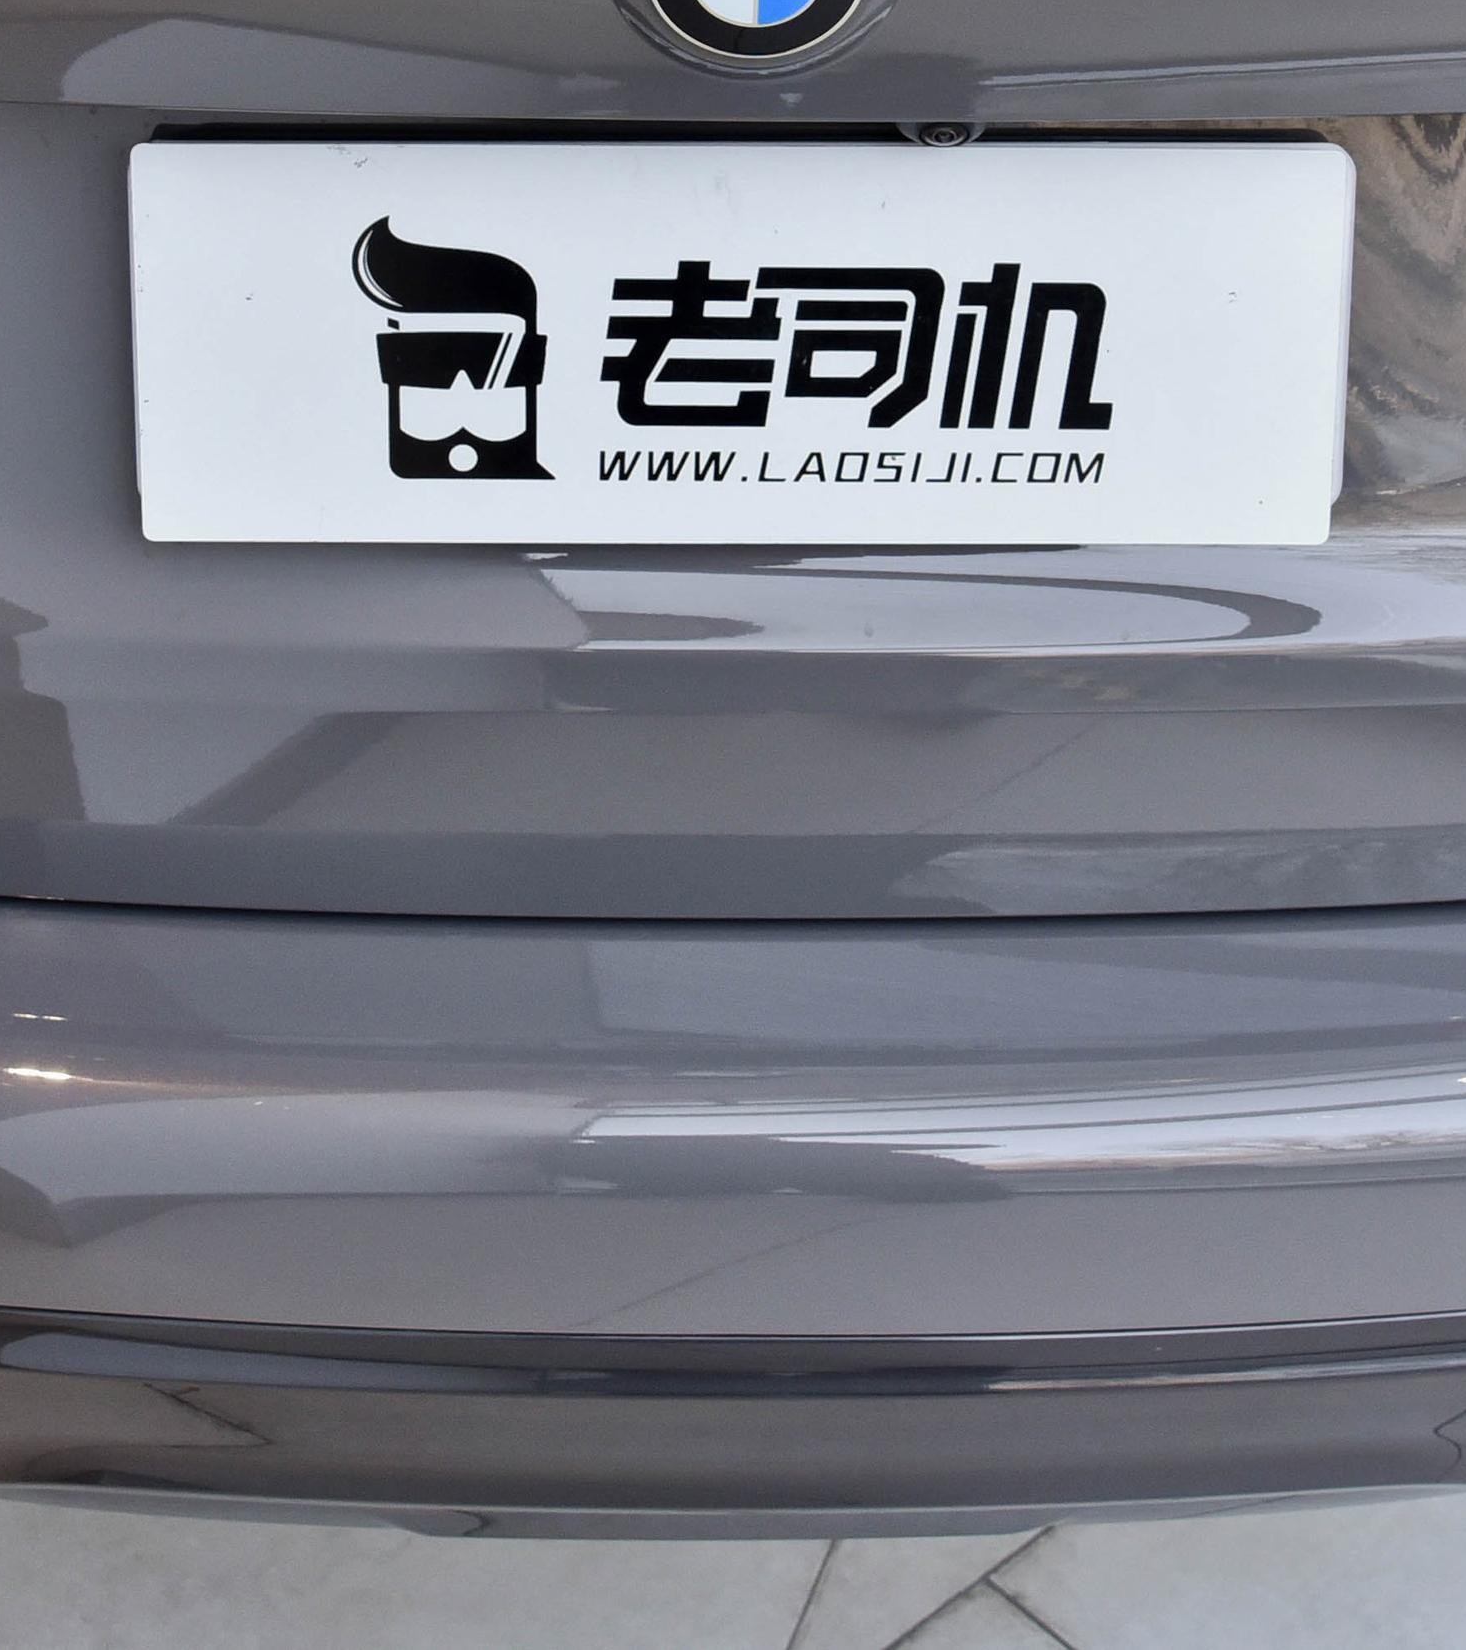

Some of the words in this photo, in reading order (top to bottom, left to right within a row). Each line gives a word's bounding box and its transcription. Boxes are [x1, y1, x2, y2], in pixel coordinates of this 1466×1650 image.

[601, 259, 1114, 431] 老司机
[596, 448, 1106, 484] WWW.LAOSIJI.COM
